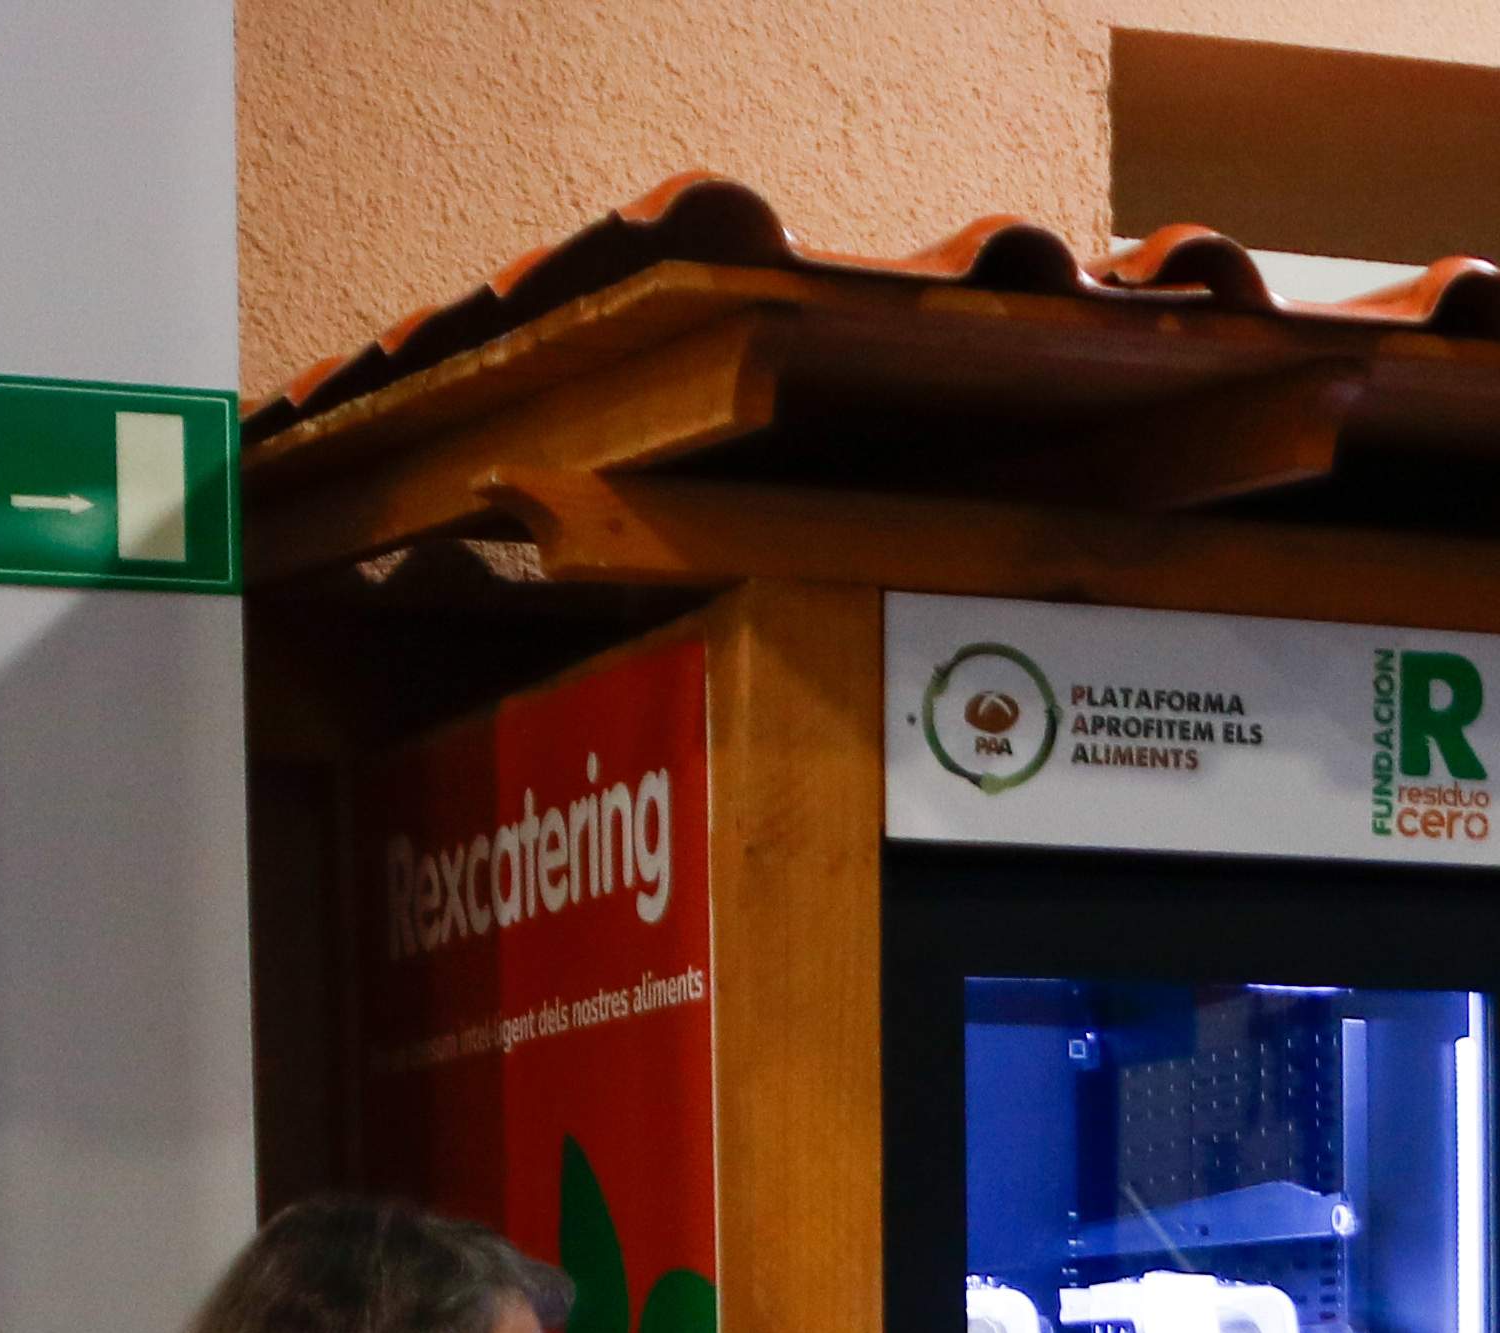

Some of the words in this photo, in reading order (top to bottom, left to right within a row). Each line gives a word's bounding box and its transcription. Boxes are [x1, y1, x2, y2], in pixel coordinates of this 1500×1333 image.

[1071, 685, 1245, 716] PLATAFORMA
[1399, 650, 1488, 780] R
[1071, 714, 1214, 743] APROFITEM
[1222, 722, 1263, 746] ELS
[1071, 743, 1199, 770] ALIMENTS
[1398, 781, 1490, 808] residuo
[1396, 806, 1490, 841] cero
[386, 751, 674, 962] Rexcatering
[538, 996, 569, 1036] dels
[572, 986, 629, 1028] nostres
[632, 964, 704, 1014] aliments
